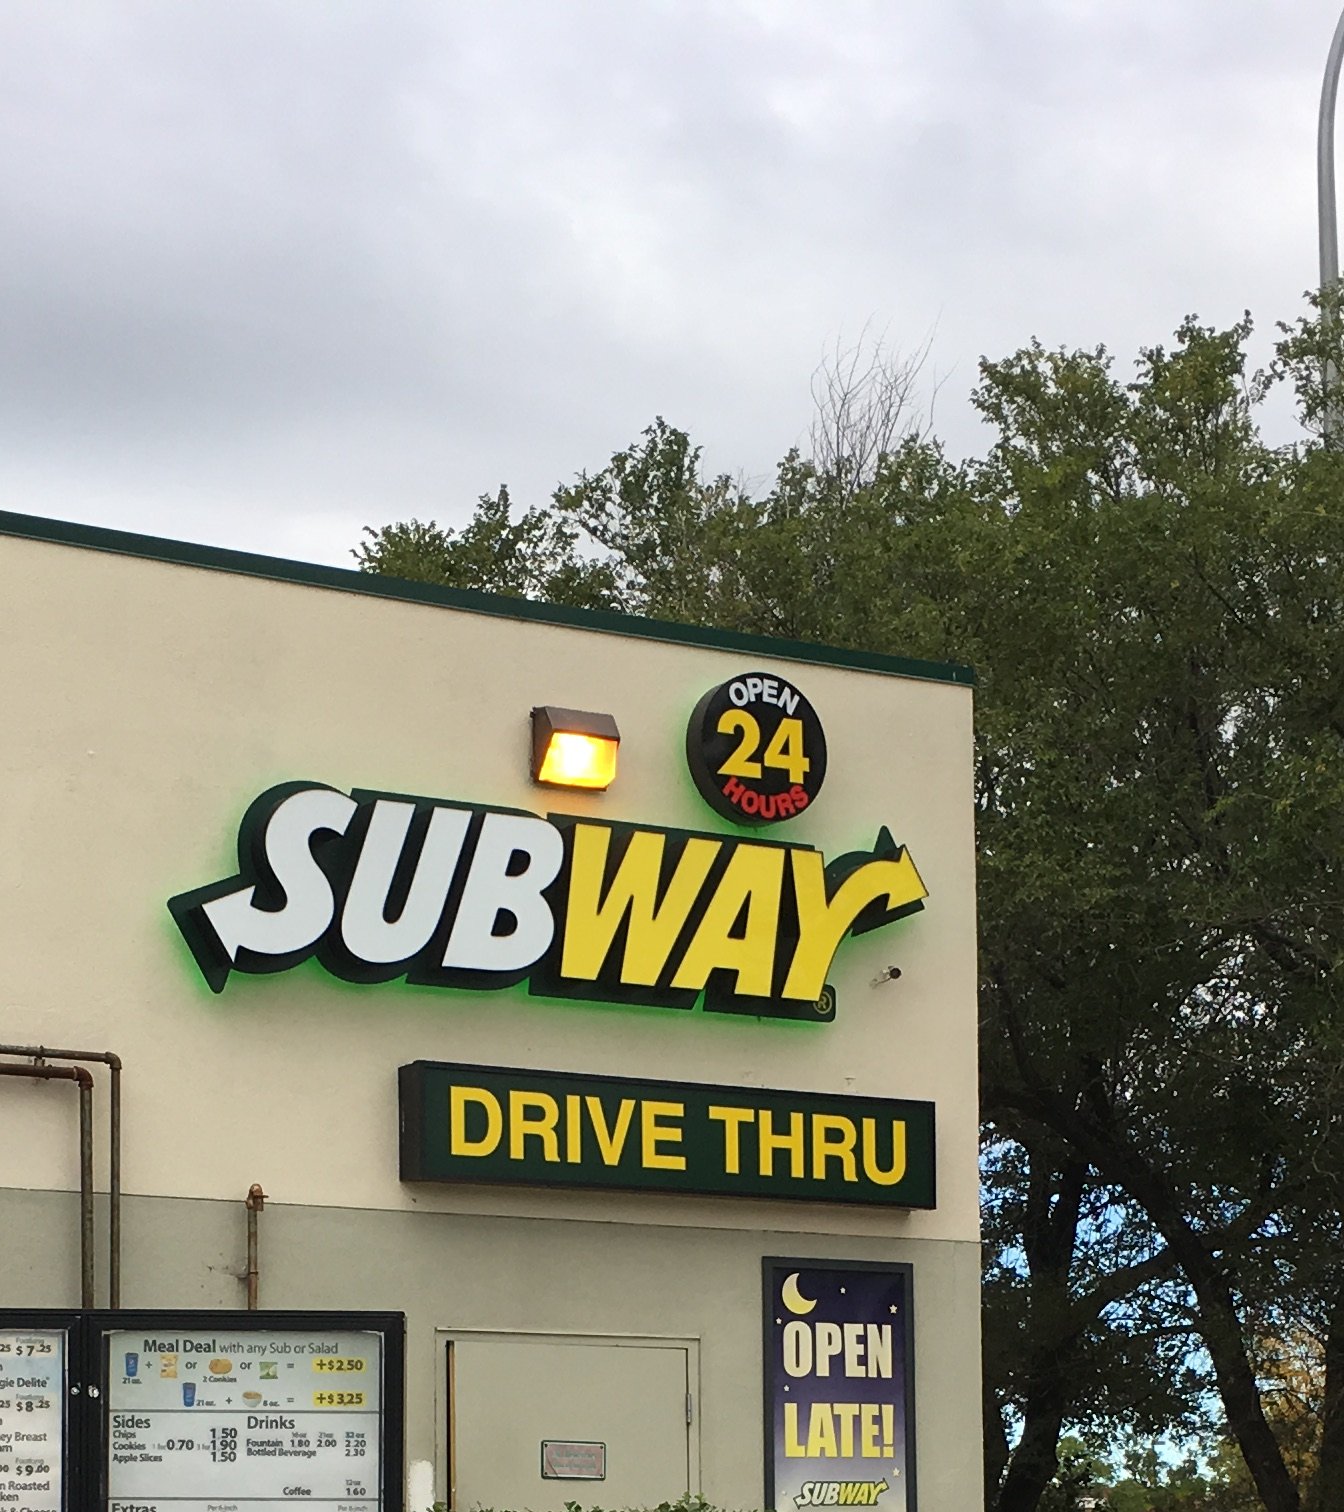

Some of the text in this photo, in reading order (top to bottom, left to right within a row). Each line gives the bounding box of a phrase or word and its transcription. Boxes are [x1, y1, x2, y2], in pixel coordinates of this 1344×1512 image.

[729, 677, 800, 716] OPEN
[717, 708, 810, 784] 24
[722, 775, 809, 819] HOURS
[203, 789, 929, 1002] SUBWAY
[450, 1085, 906, 1186] DRIVE THRU
[144, 1339, 338, 1356] Meal Deal with any Sub or Salad
[783, 1320, 893, 1379] OPEN
[240, 1362, 252, 1370] or
[113, 1416, 151, 1429] Sides
[247, 1416, 295, 1429] Drinks
[15, 1432, 47, 1441] Breast
[113, 1428, 237, 1440] Chips 1.50
[784, 1402, 894, 1458] LATE!
[113, 1440, 237, 1451] Cookies 0.70 1.90
[246, 1439, 283, 1448] Fountain
[317, 1440, 337, 1448] 2.00
[345, 1440, 366, 1448] 2.20
[113, 1452, 236, 1463] Apple Slices 1.50
[247, 1449, 276, 1457] Bottled
[278, 1449, 316, 1458] Beverage
[8, 1481, 49, 1490] Roasted
[283, 1487, 311, 1496] Coffee
[794, 1478, 889, 1508] SUBWAY
